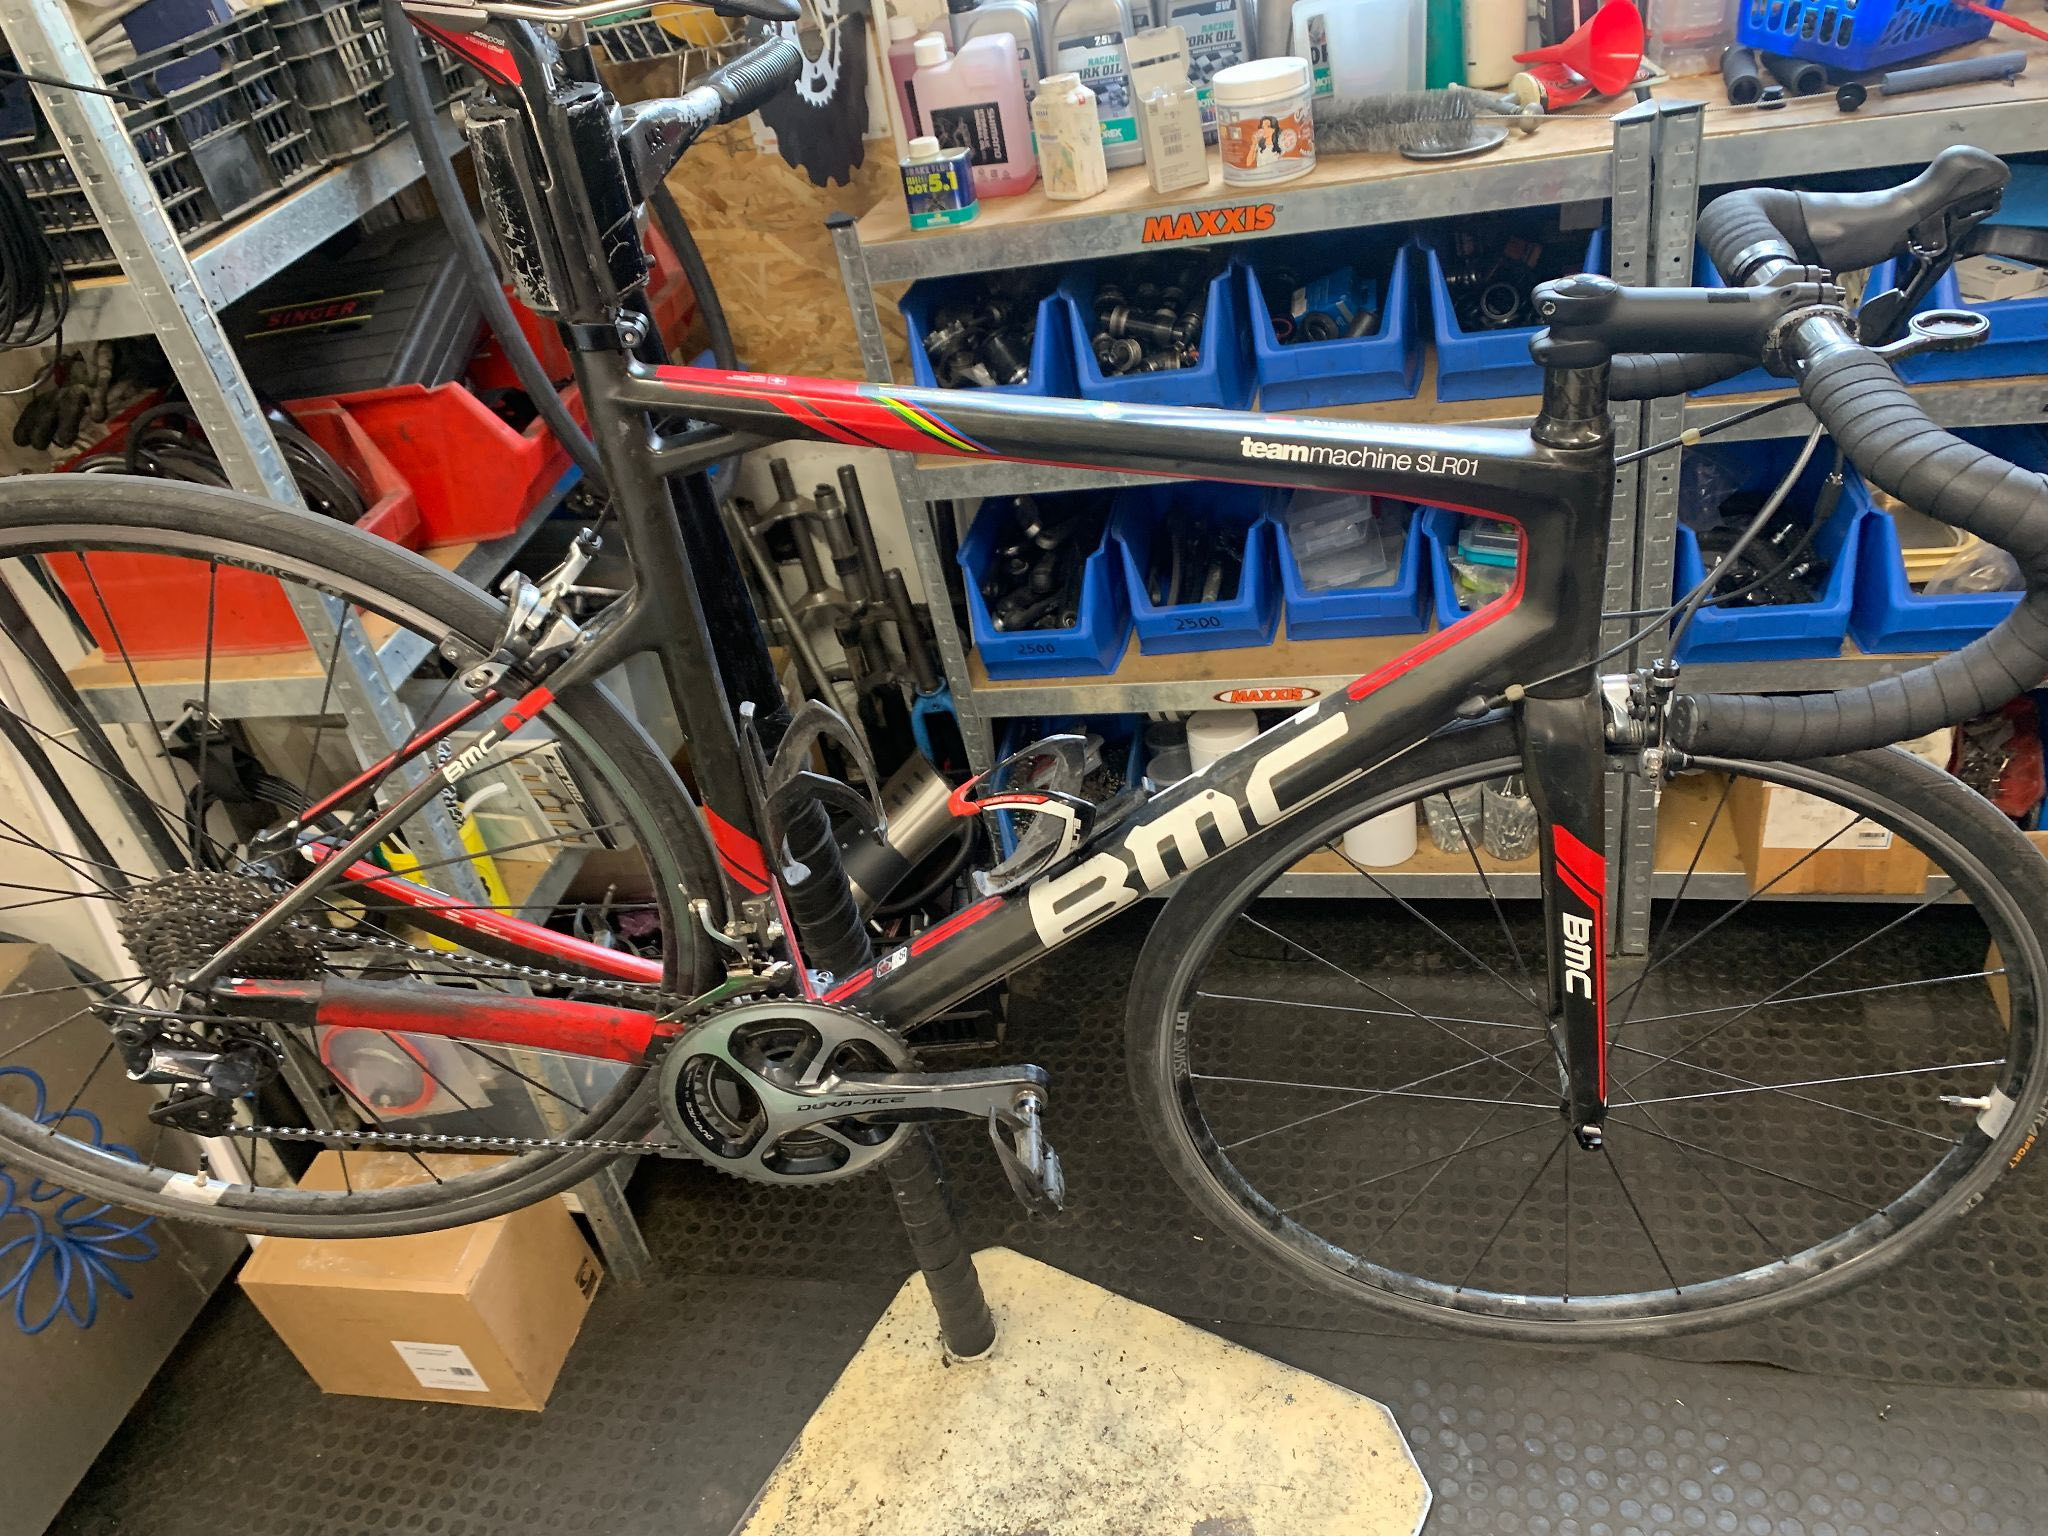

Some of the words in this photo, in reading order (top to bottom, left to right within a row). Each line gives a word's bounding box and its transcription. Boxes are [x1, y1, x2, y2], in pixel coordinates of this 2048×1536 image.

[1186, 32, 1213, 48] ORK
[1215, 28, 1237, 42] OIL
[1102, 62, 1123, 76] OIL
[986, 107, 1002, 159] SHIMANO
[907, 183, 929, 195] DOT
[928, 170, 959, 193] 5.1
[1141, 203, 1276, 244] MAXXIS
[267, 301, 357, 326] SINGER
[1240, 436, 1411, 471] teammachine
[1415, 454, 1480, 476] SLR01
[1174, 615, 1222, 631] 2500
[1017, 642, 1056, 655] 2500
[1230, 687, 1304, 704] MAXXIS
[1562, 911, 1593, 1000] BMC
[1175, 1010, 1190, 1033] DT
[1173, 1036, 1187, 1078] SWISS
[796, 1096, 908, 1112] DURA-ACE
[686, 1101, 714, 1142] DURA-ACE
[2008, 1134, 2036, 1169] SPORT
